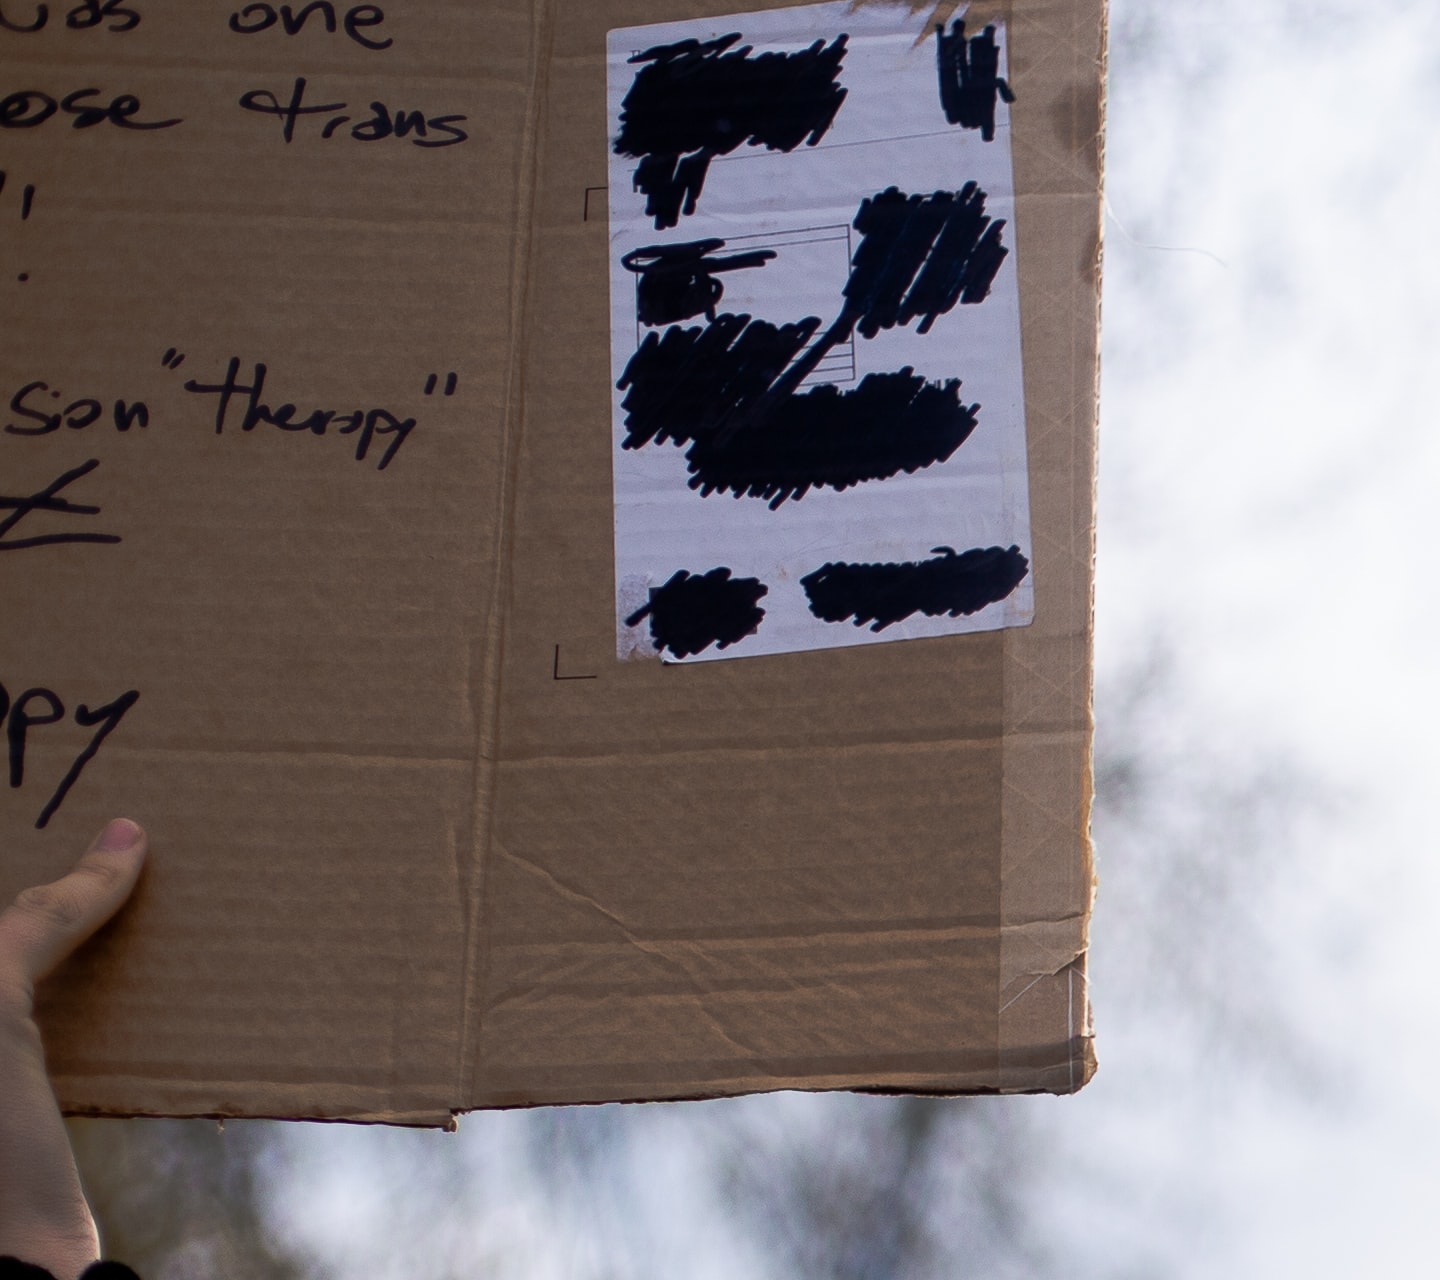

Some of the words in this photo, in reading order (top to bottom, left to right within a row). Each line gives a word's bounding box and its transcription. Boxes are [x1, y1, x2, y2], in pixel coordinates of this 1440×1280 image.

[228, 1, 394, 51] one
[238, 76, 470, 148] trans
[0, 684, 141, 830] py
